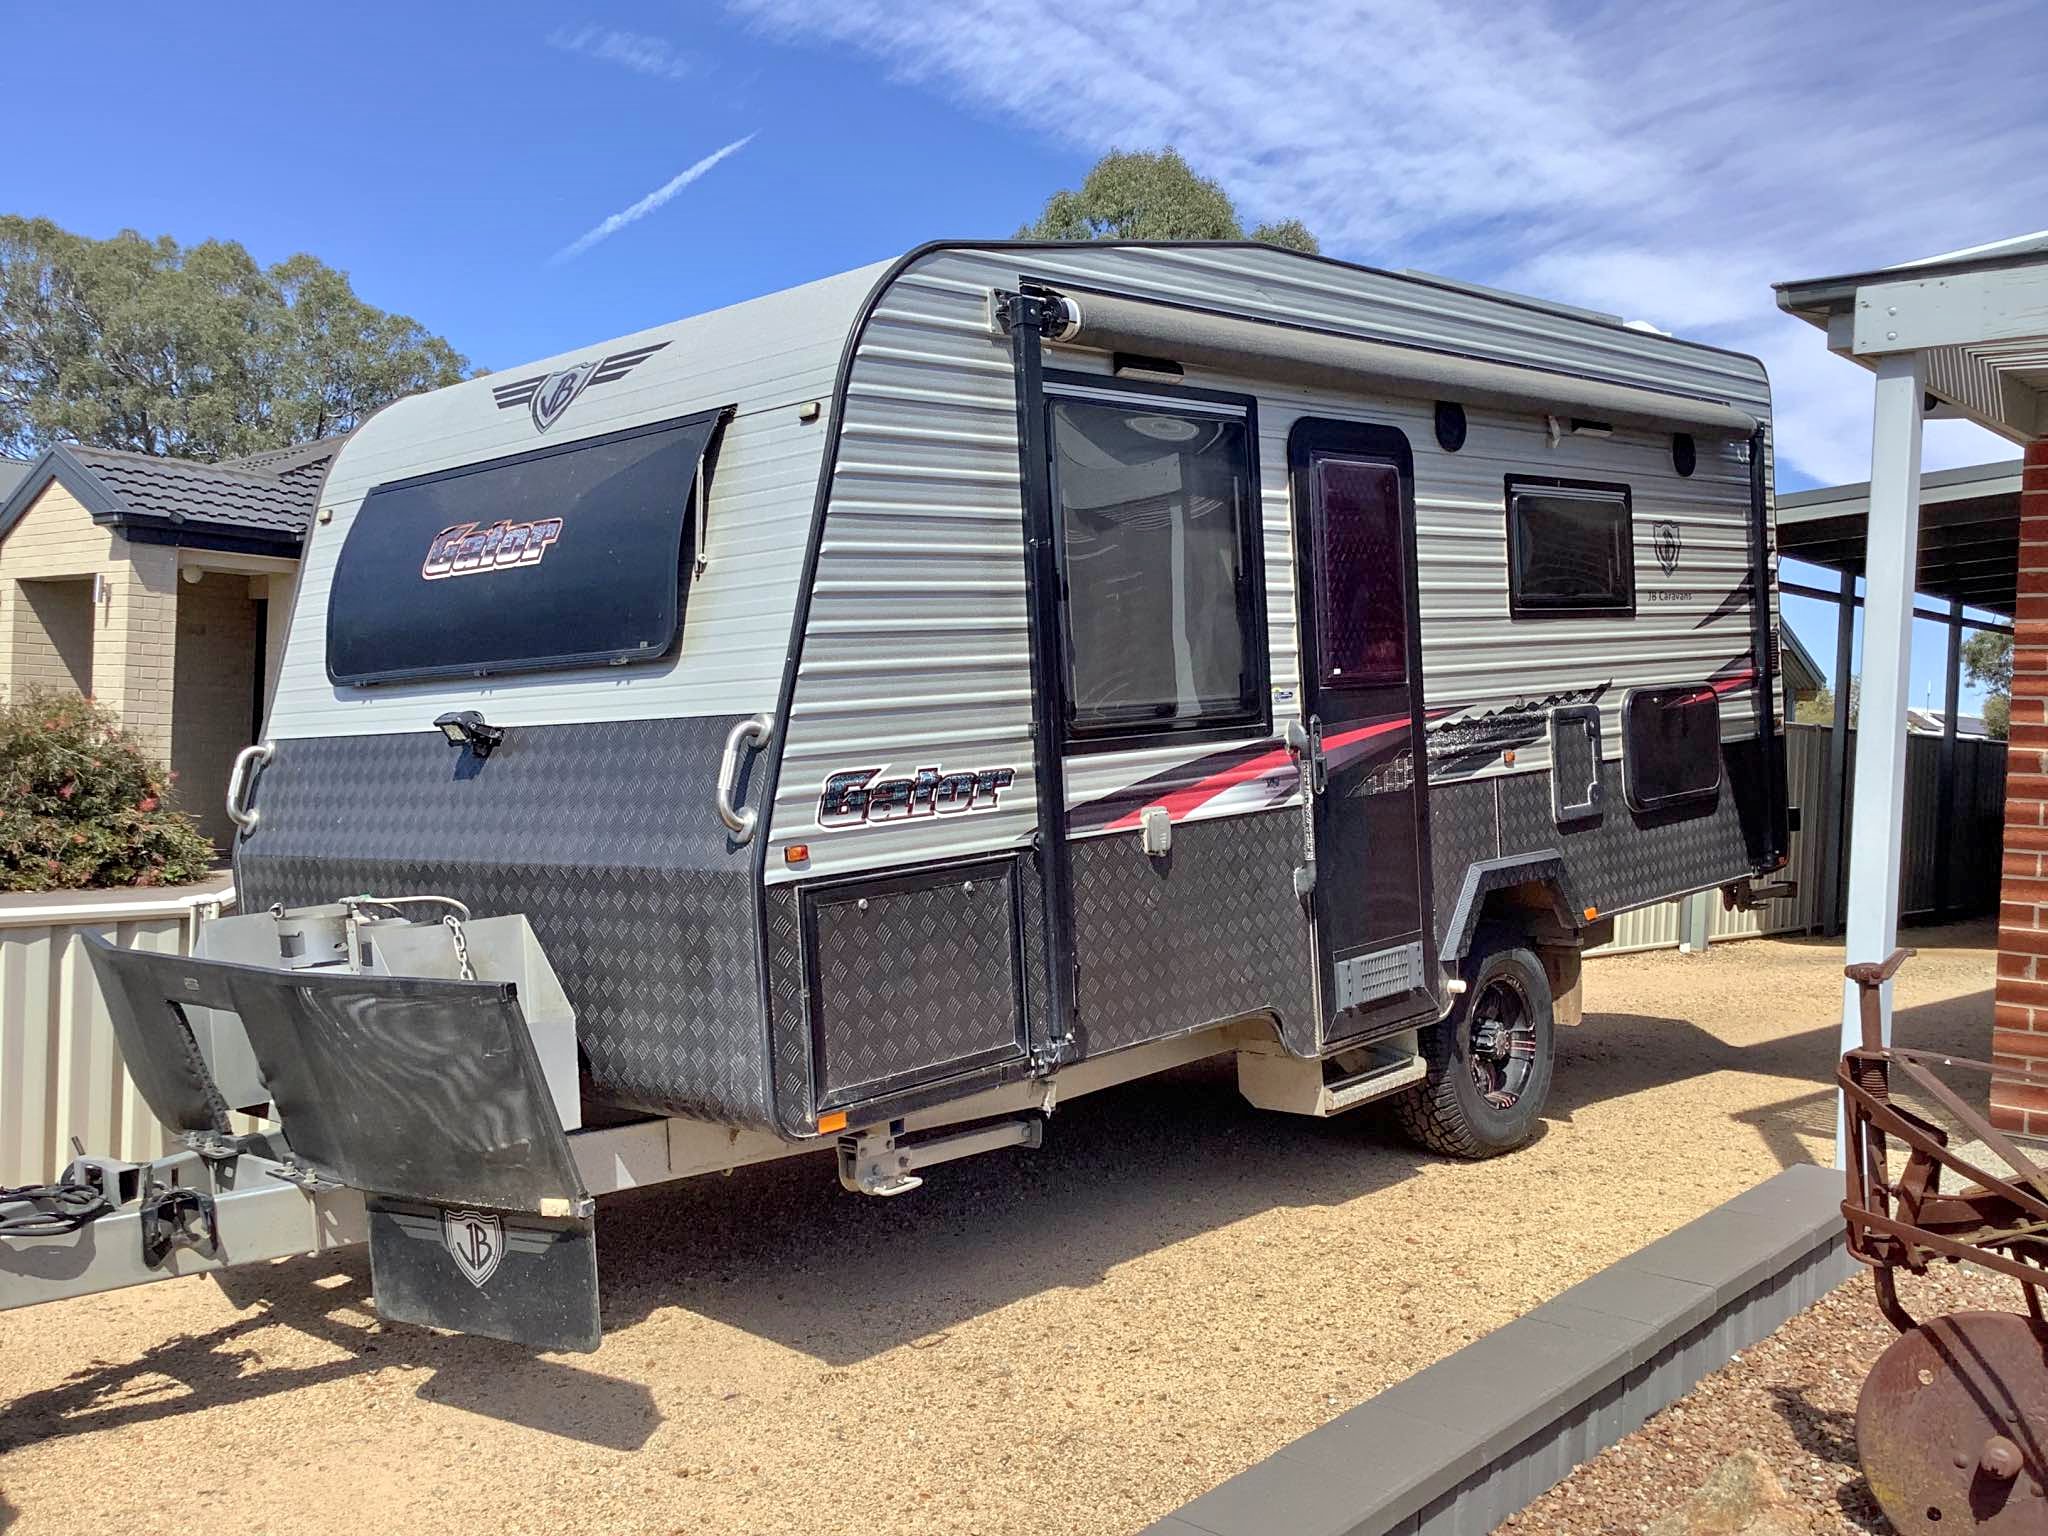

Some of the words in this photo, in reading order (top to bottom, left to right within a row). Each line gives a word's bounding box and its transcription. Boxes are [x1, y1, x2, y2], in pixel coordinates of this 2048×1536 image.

[541, 373, 578, 418] JB
[422, 517, 563, 580] Gator
[1659, 591, 1693, 601] Caravans
[815, 764, 1017, 831] Gator
[458, 1222, 493, 1271] JB
